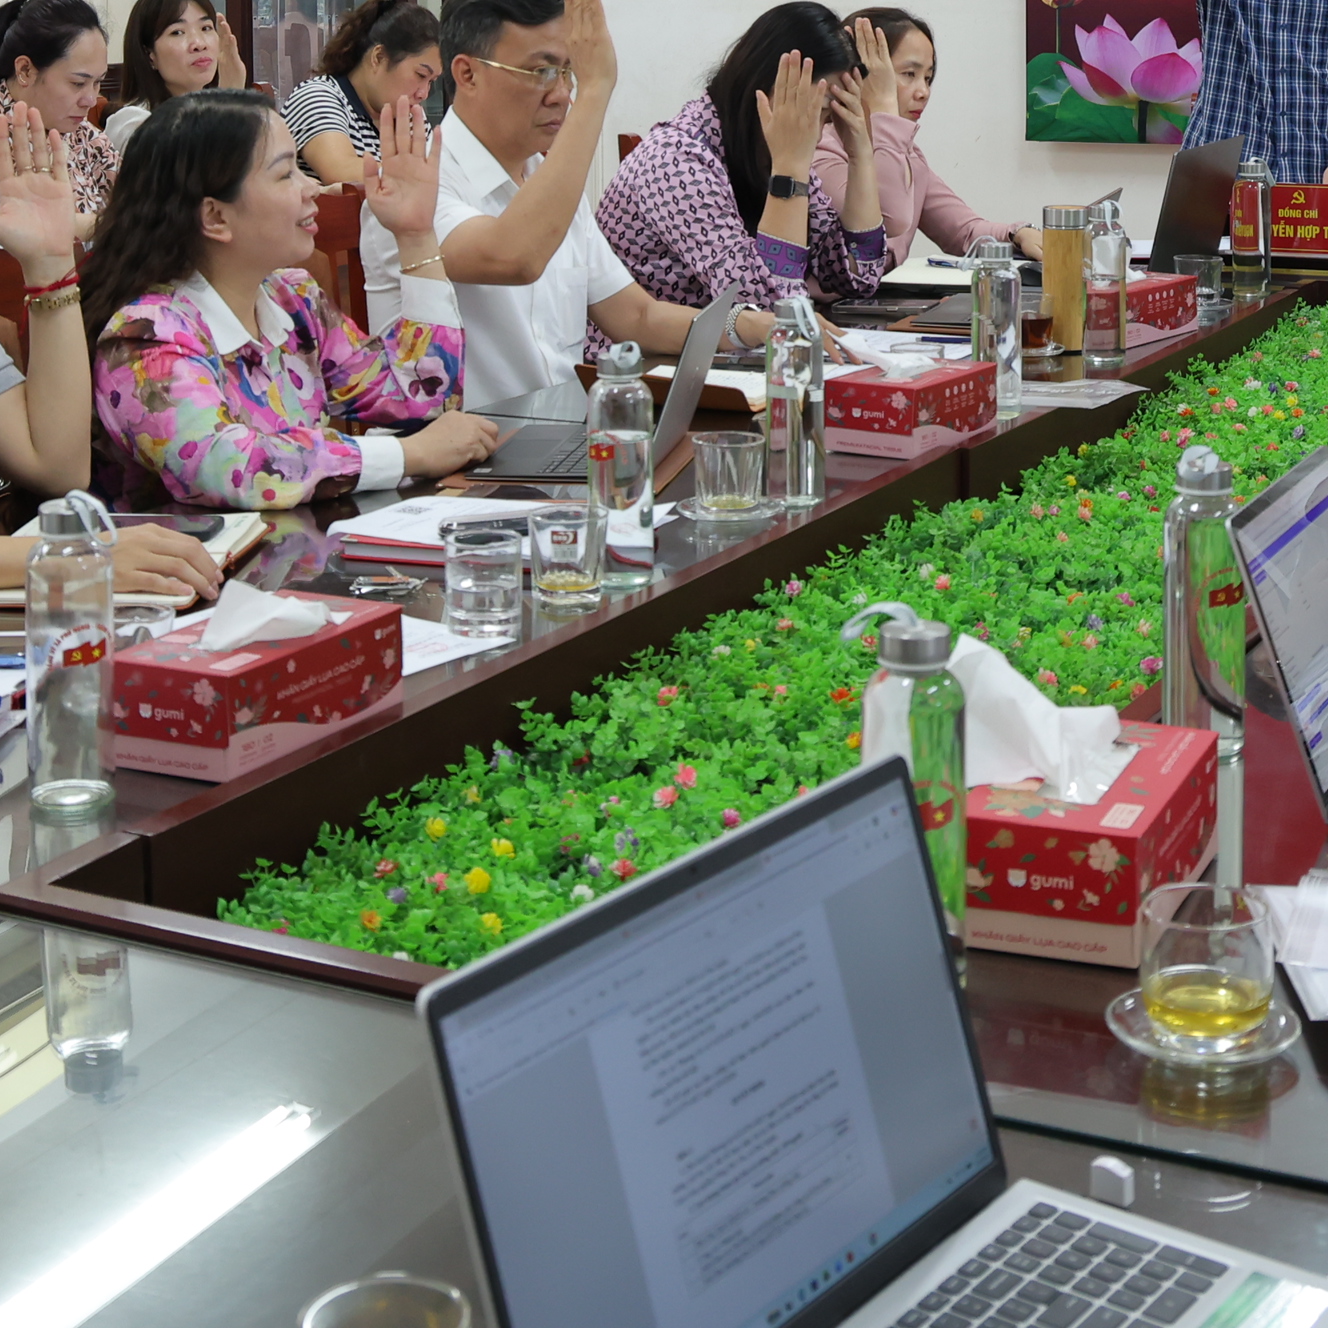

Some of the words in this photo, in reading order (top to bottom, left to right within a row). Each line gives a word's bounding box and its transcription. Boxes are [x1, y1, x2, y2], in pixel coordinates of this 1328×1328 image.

[1297, 224, 1321, 242] HỢP
[863, 410, 885, 420] gumi
[153, 708, 185, 722] gumi
[1029, 874, 1074, 891] gumi
